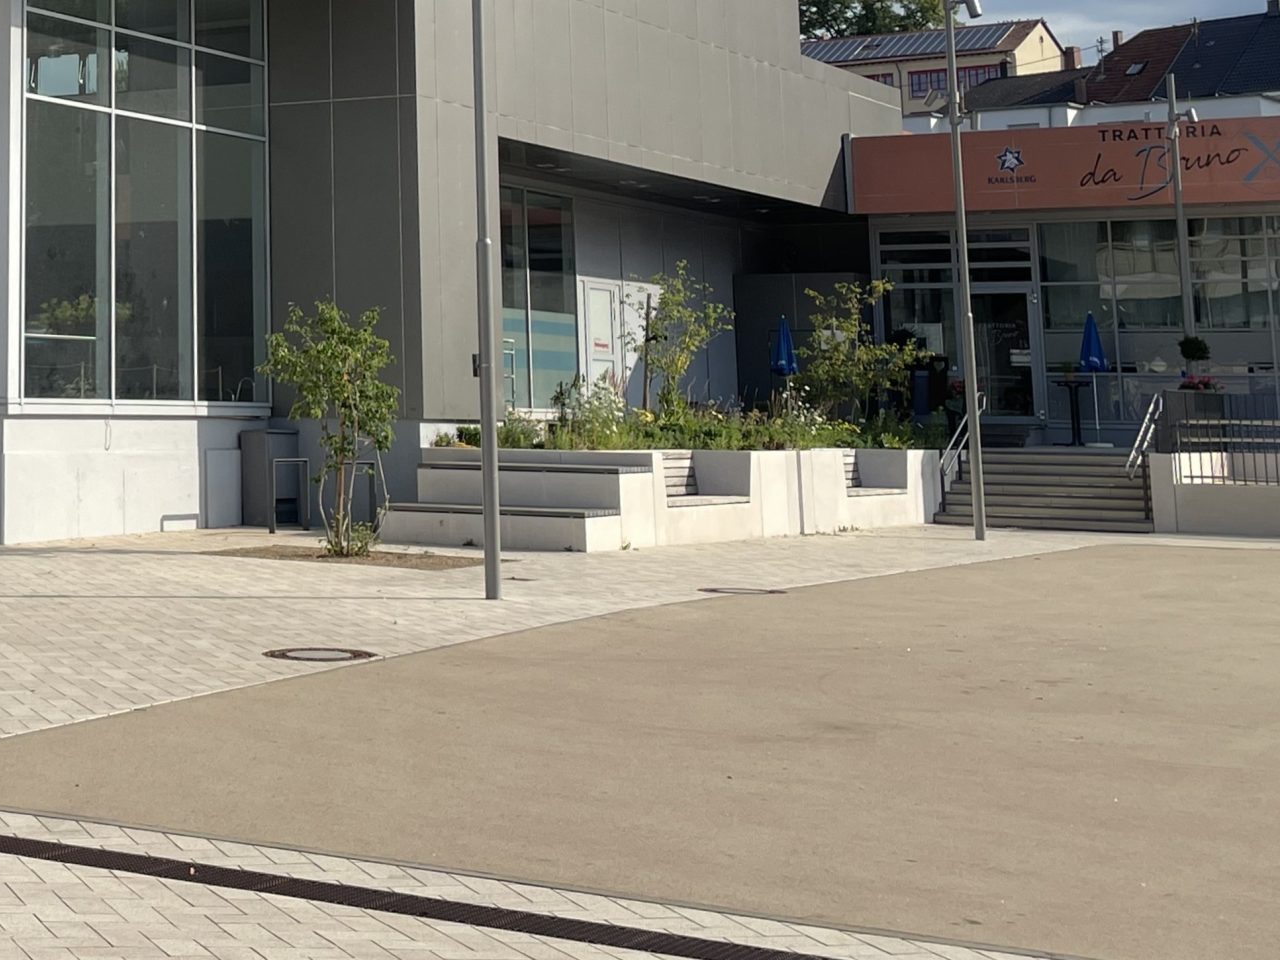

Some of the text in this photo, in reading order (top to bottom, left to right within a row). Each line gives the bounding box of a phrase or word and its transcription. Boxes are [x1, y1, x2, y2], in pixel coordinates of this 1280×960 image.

[1098, 124, 1222, 142] TRATTRIA
[987, 175, 1037, 185] KARLSBERG
[1079, 145, 1248, 201] da Bruno
